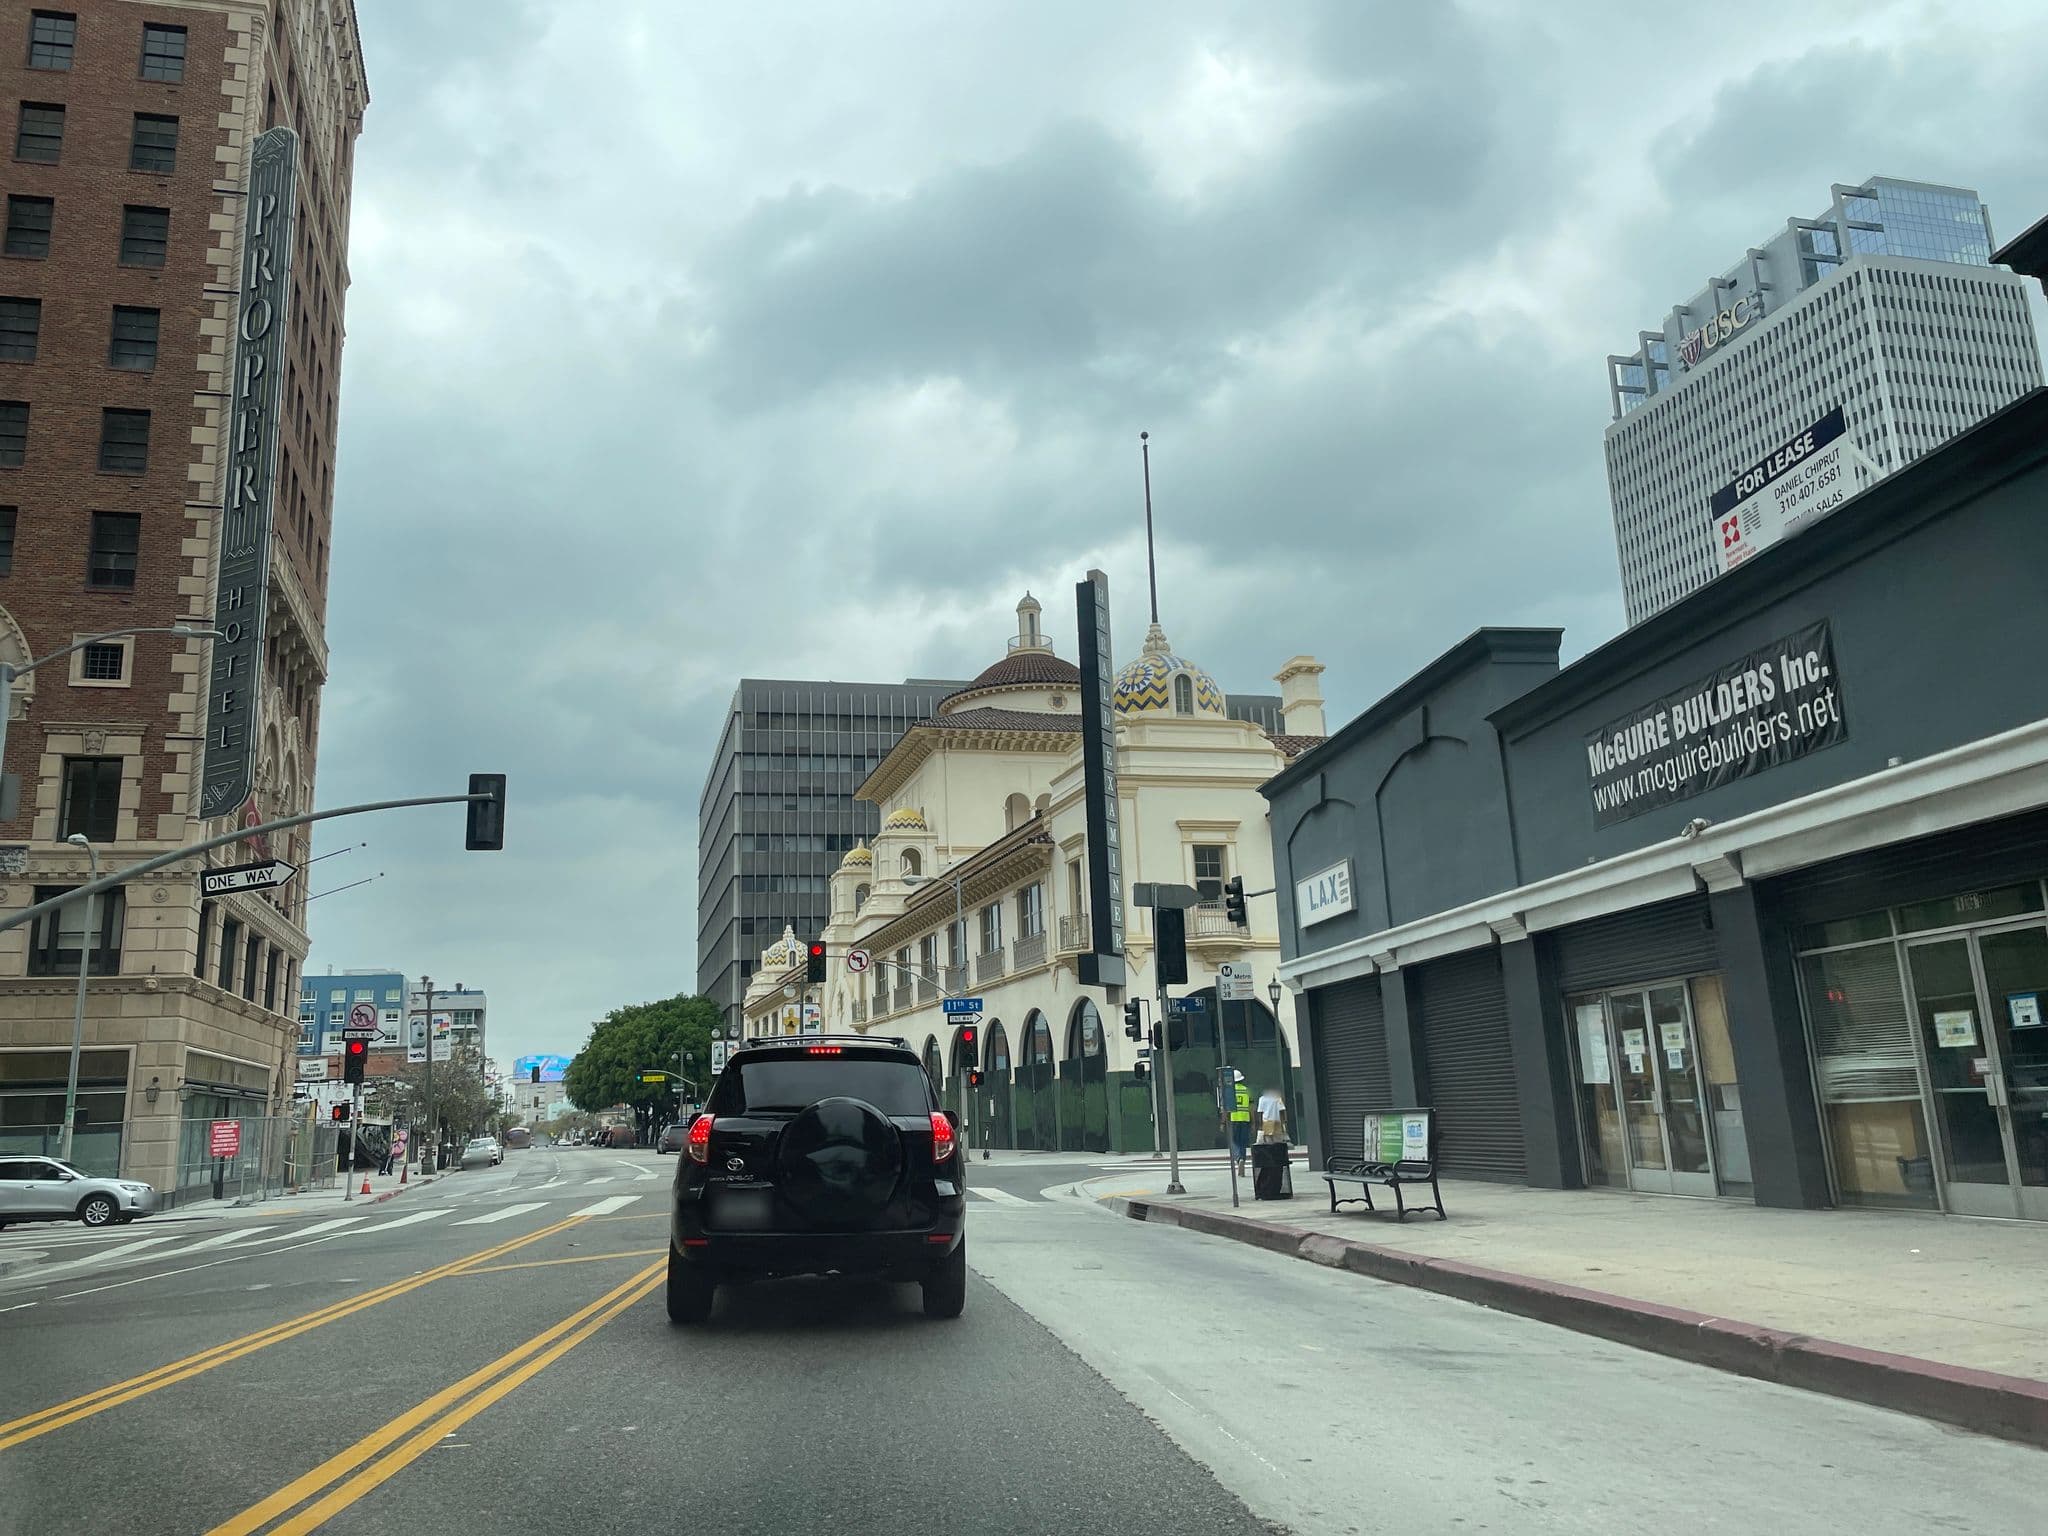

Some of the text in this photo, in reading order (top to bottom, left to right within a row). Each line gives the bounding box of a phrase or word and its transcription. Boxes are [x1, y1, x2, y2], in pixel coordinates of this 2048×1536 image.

[232, 193, 278, 511] PROPER
[1702, 297, 1752, 350] USC
[1735, 431, 1815, 500] FOR LEASE
[1774, 447, 1841, 500] DANIEL CHIPRUT
[1780, 464, 1841, 514] 310.407.6581
[1816, 489, 1844, 513] SALAS
[218, 586, 243, 752] HOTEL
[1098, 587, 1111, 727] HERALD
[1587, 650, 1830, 777] McGUIRE BUILDERS Inc.
[1593, 686, 1840, 812] www.mcguirebuilders.net
[207, 868, 274, 890] ONE WAY
[1106, 751, 1122, 950] EXAMINER
[947, 1000, 978, 1010] 11th St
